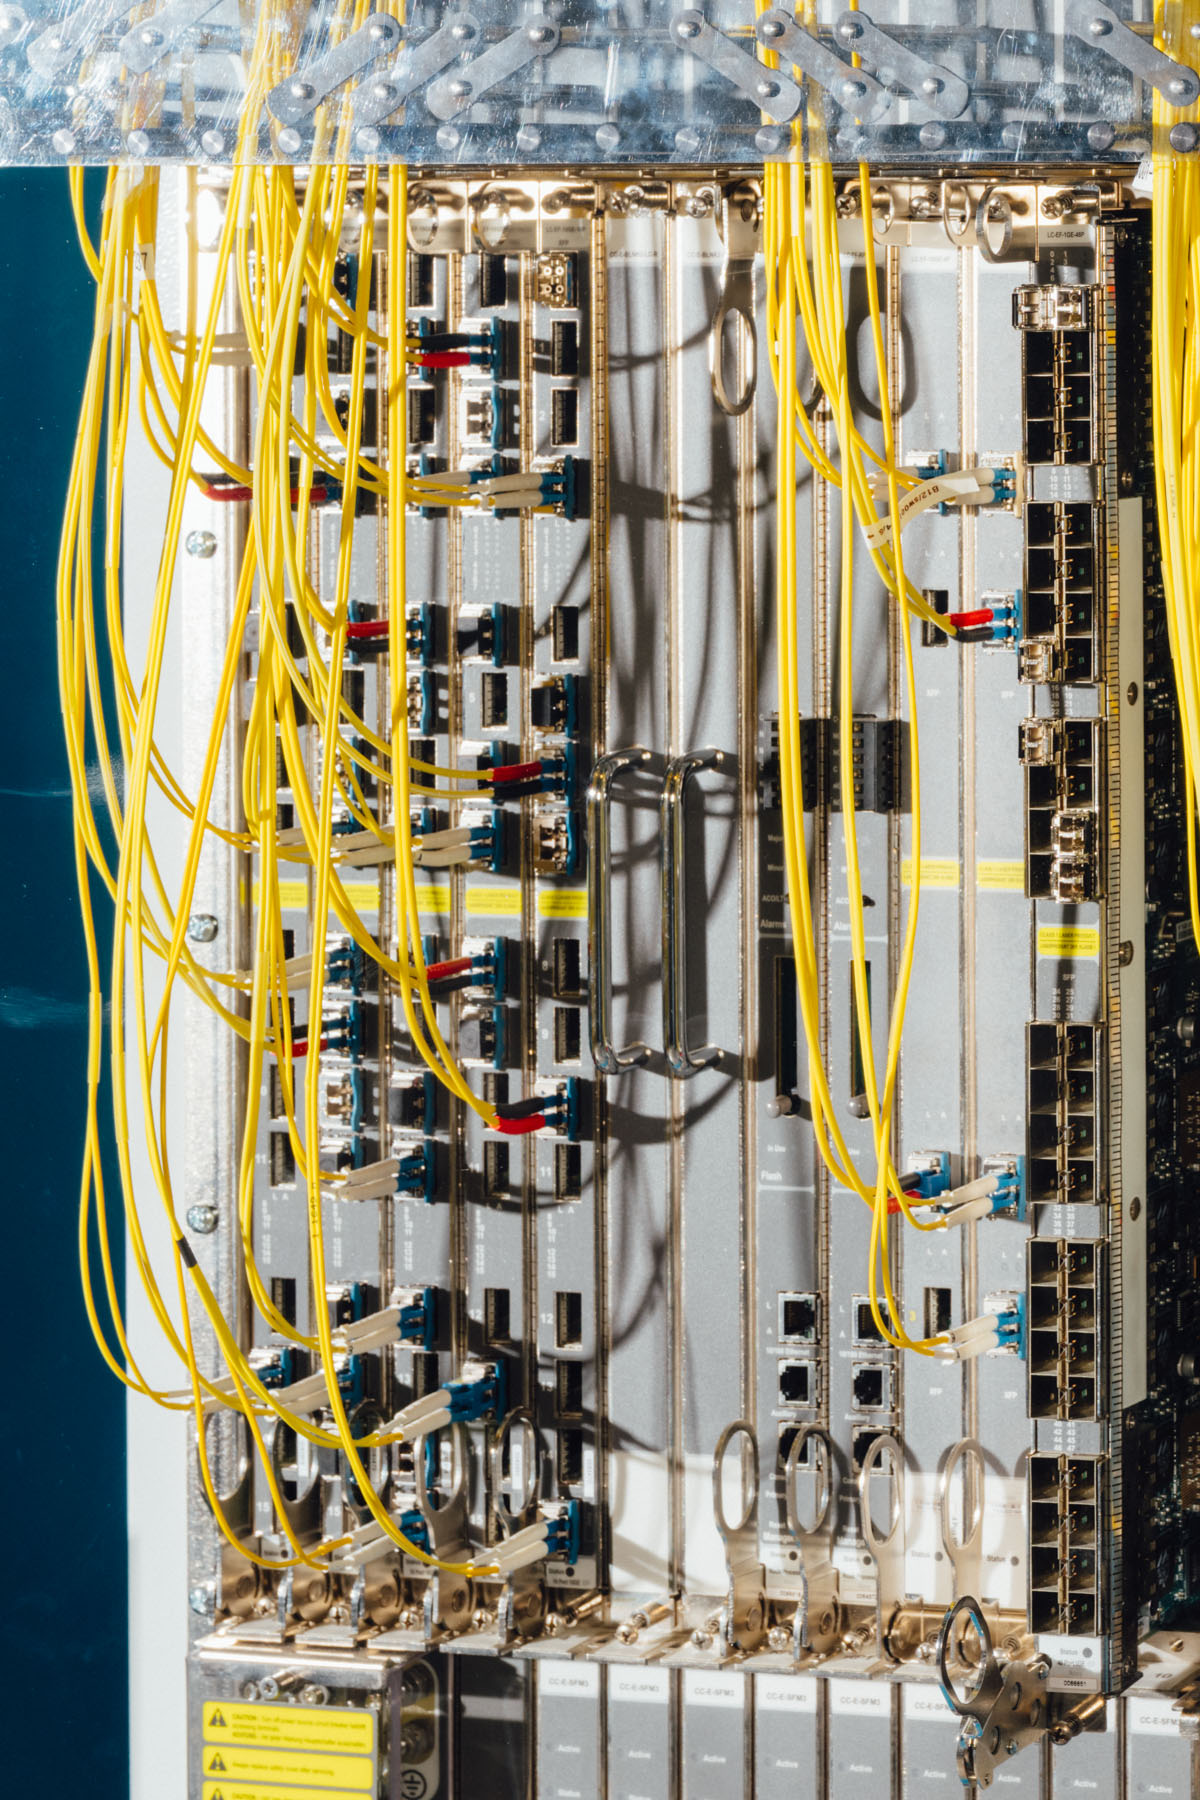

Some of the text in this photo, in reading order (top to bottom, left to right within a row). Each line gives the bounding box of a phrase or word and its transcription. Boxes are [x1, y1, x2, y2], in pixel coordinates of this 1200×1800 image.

[558, 1744, 581, 1753] Active
[628, 1750, 651, 1759] Active
[703, 1754, 726, 1764] Active
[776, 1760, 798, 1769] Active
[850, 1764, 873, 1773] Active
[923, 1770, 947, 1779] Active
[998, 1774, 1021, 1784] Active
[1073, 1779, 1097, 1789] Active
[1149, 1784, 1173, 1794] Active
